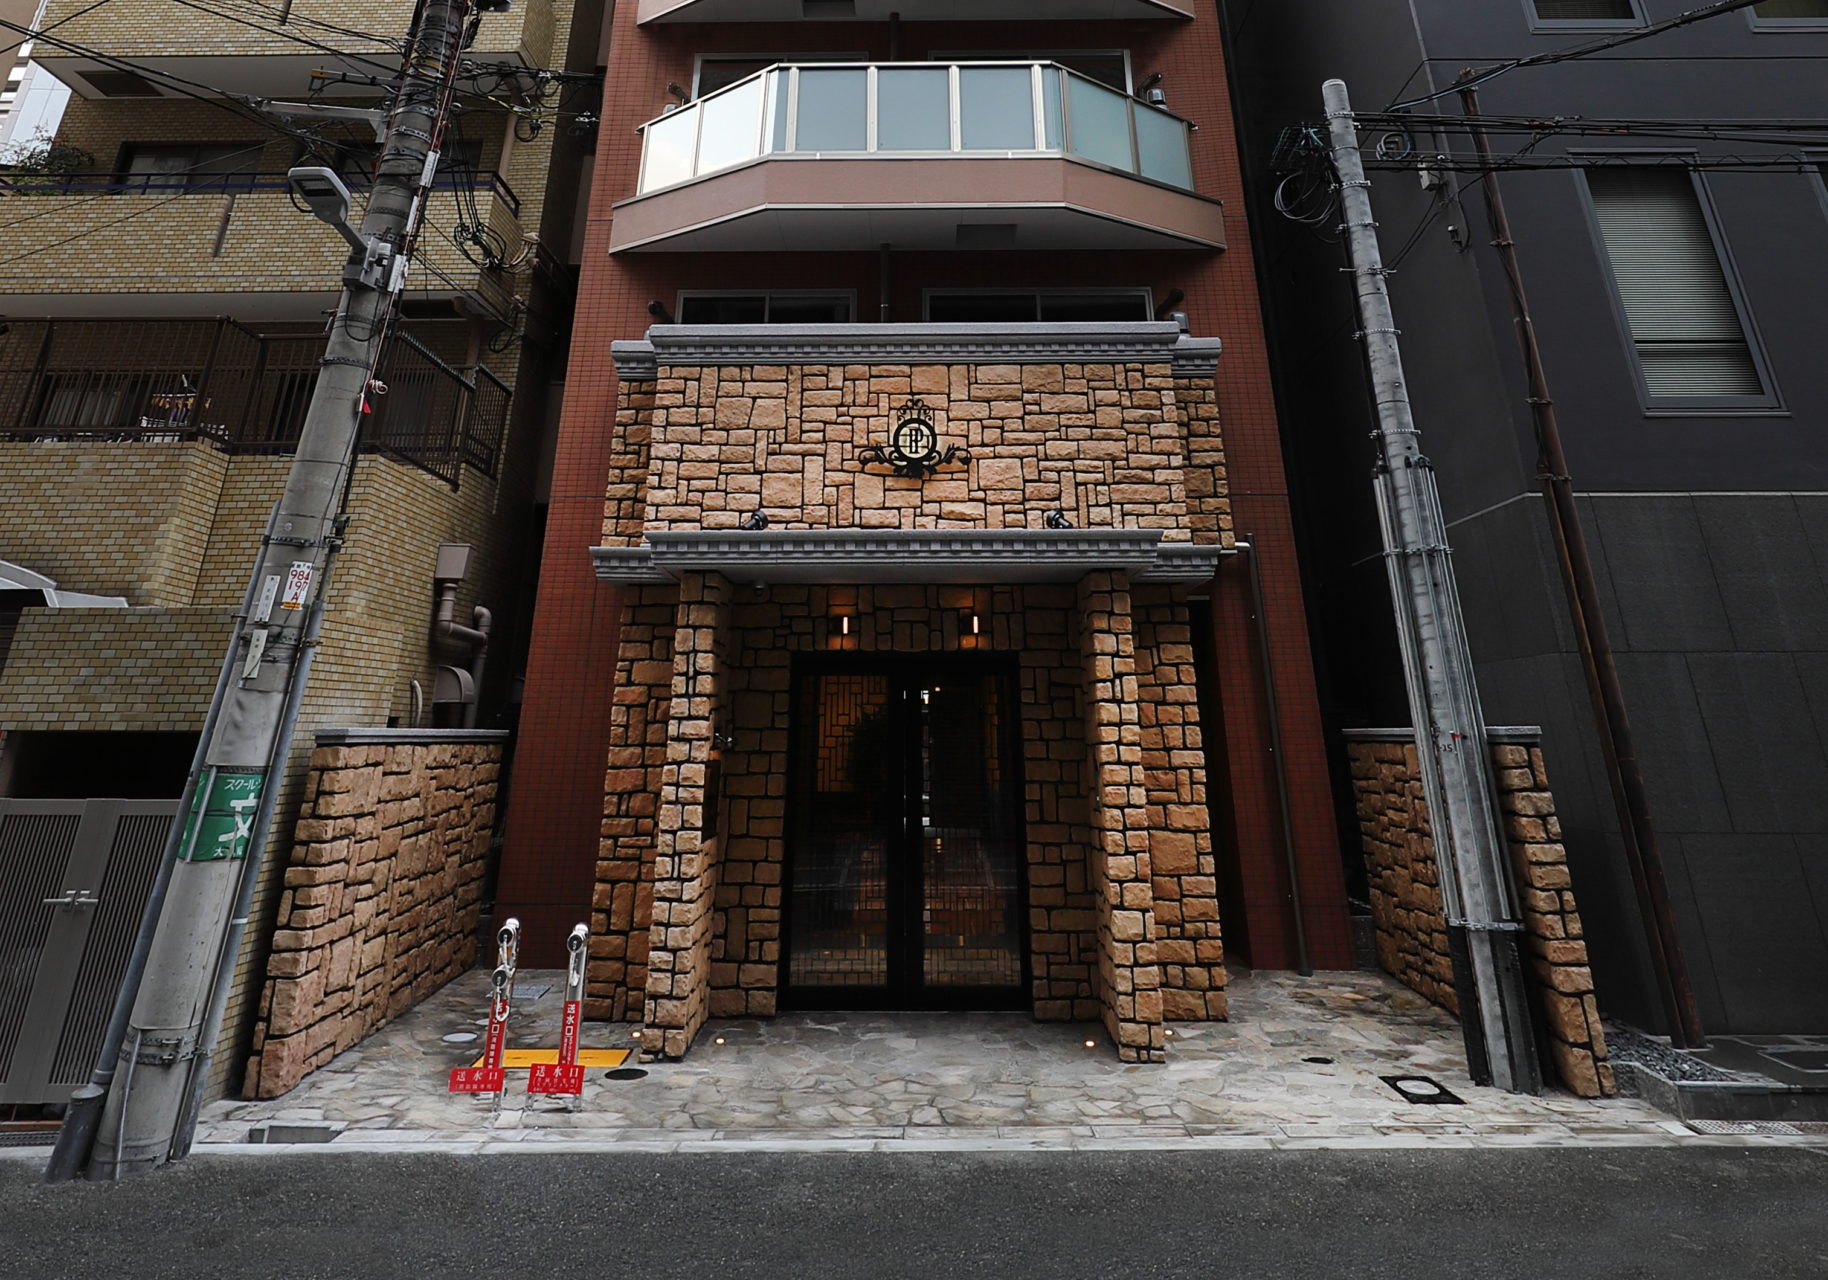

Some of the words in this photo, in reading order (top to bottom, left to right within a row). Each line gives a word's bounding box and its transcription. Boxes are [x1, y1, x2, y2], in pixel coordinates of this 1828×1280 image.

[290, 569, 311, 581] 984
[290, 591, 300, 602] A
[565, 1003, 576, 1036] 送水口
[456, 1071, 498, 1082] 送水口
[534, 1065, 579, 1078] 送水口
